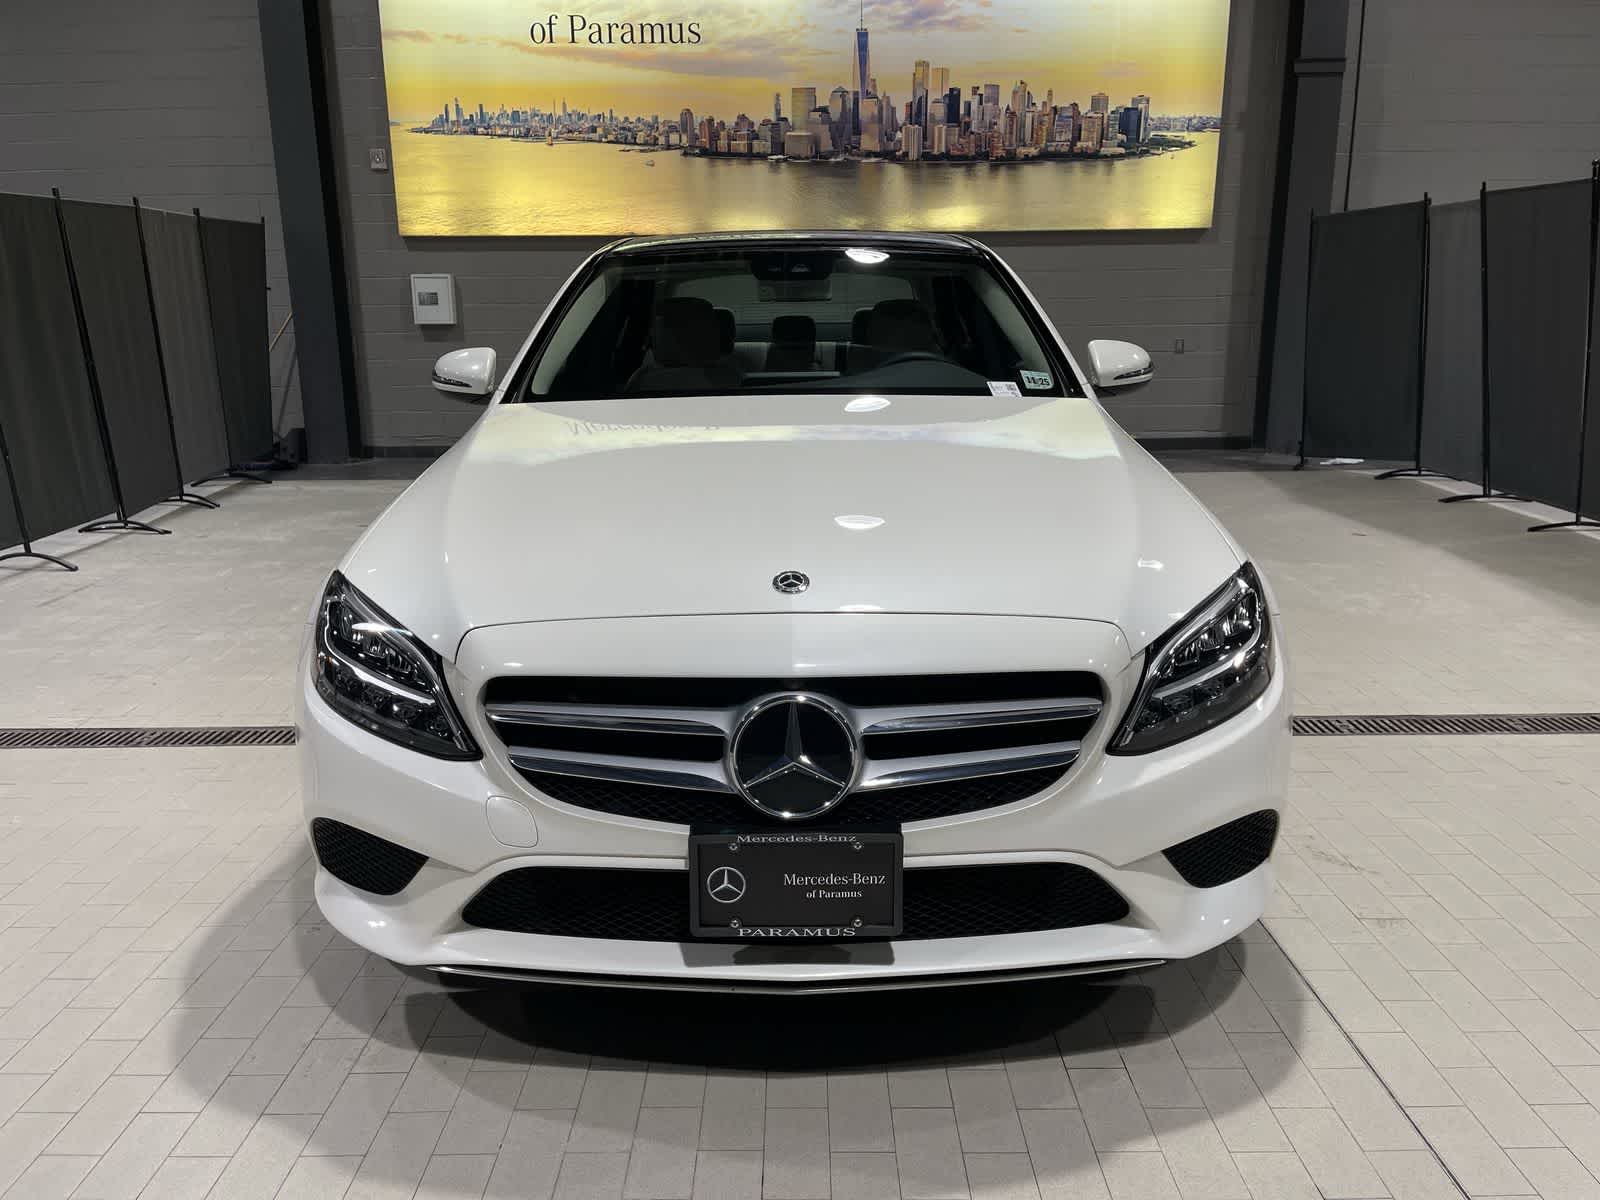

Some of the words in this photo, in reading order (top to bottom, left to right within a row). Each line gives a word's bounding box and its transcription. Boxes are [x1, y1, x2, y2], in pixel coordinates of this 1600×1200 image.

[530, 14, 558, 44] of
[567, 14, 702, 44] Paramus
[737, 834, 857, 843] Mercedes-Benz
[783, 873, 886, 886] Mercedes-Benz
[806, 889, 817, 899] of
[818, 889, 863, 899] Paramus
[738, 927, 857, 937] PARAMUS
